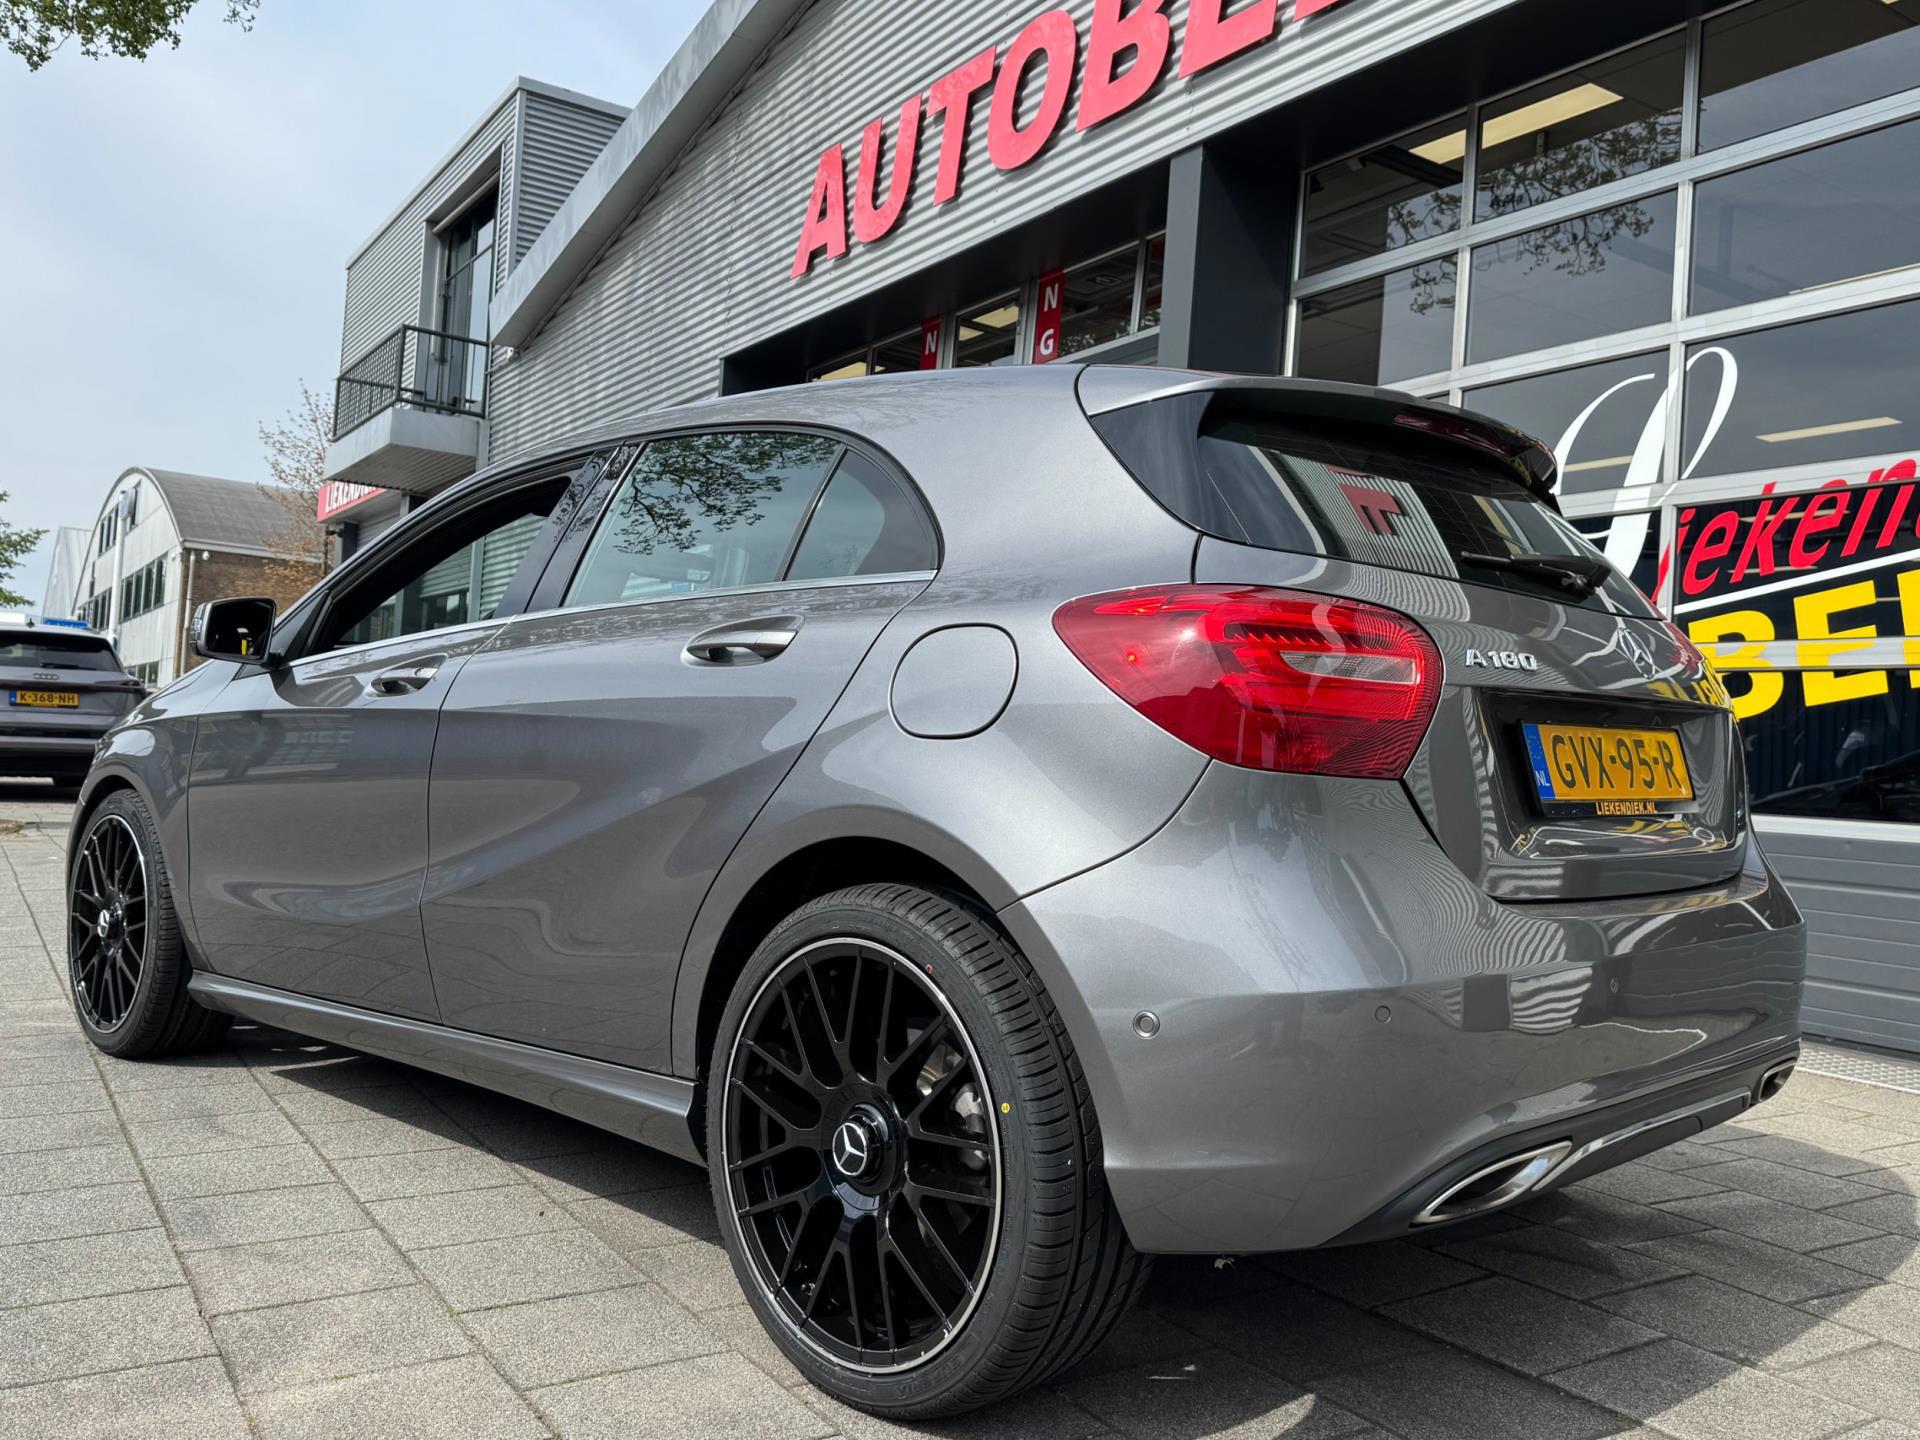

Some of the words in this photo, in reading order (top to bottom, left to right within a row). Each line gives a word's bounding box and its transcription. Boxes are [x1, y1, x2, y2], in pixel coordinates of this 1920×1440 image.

[19, 691, 76, 704] K-368-NH
[1535, 770, 1550, 787] NL
[1551, 734, 1683, 789] GVX-95-R
[1596, 801, 1658, 815] LIEKENDIEK.NL
